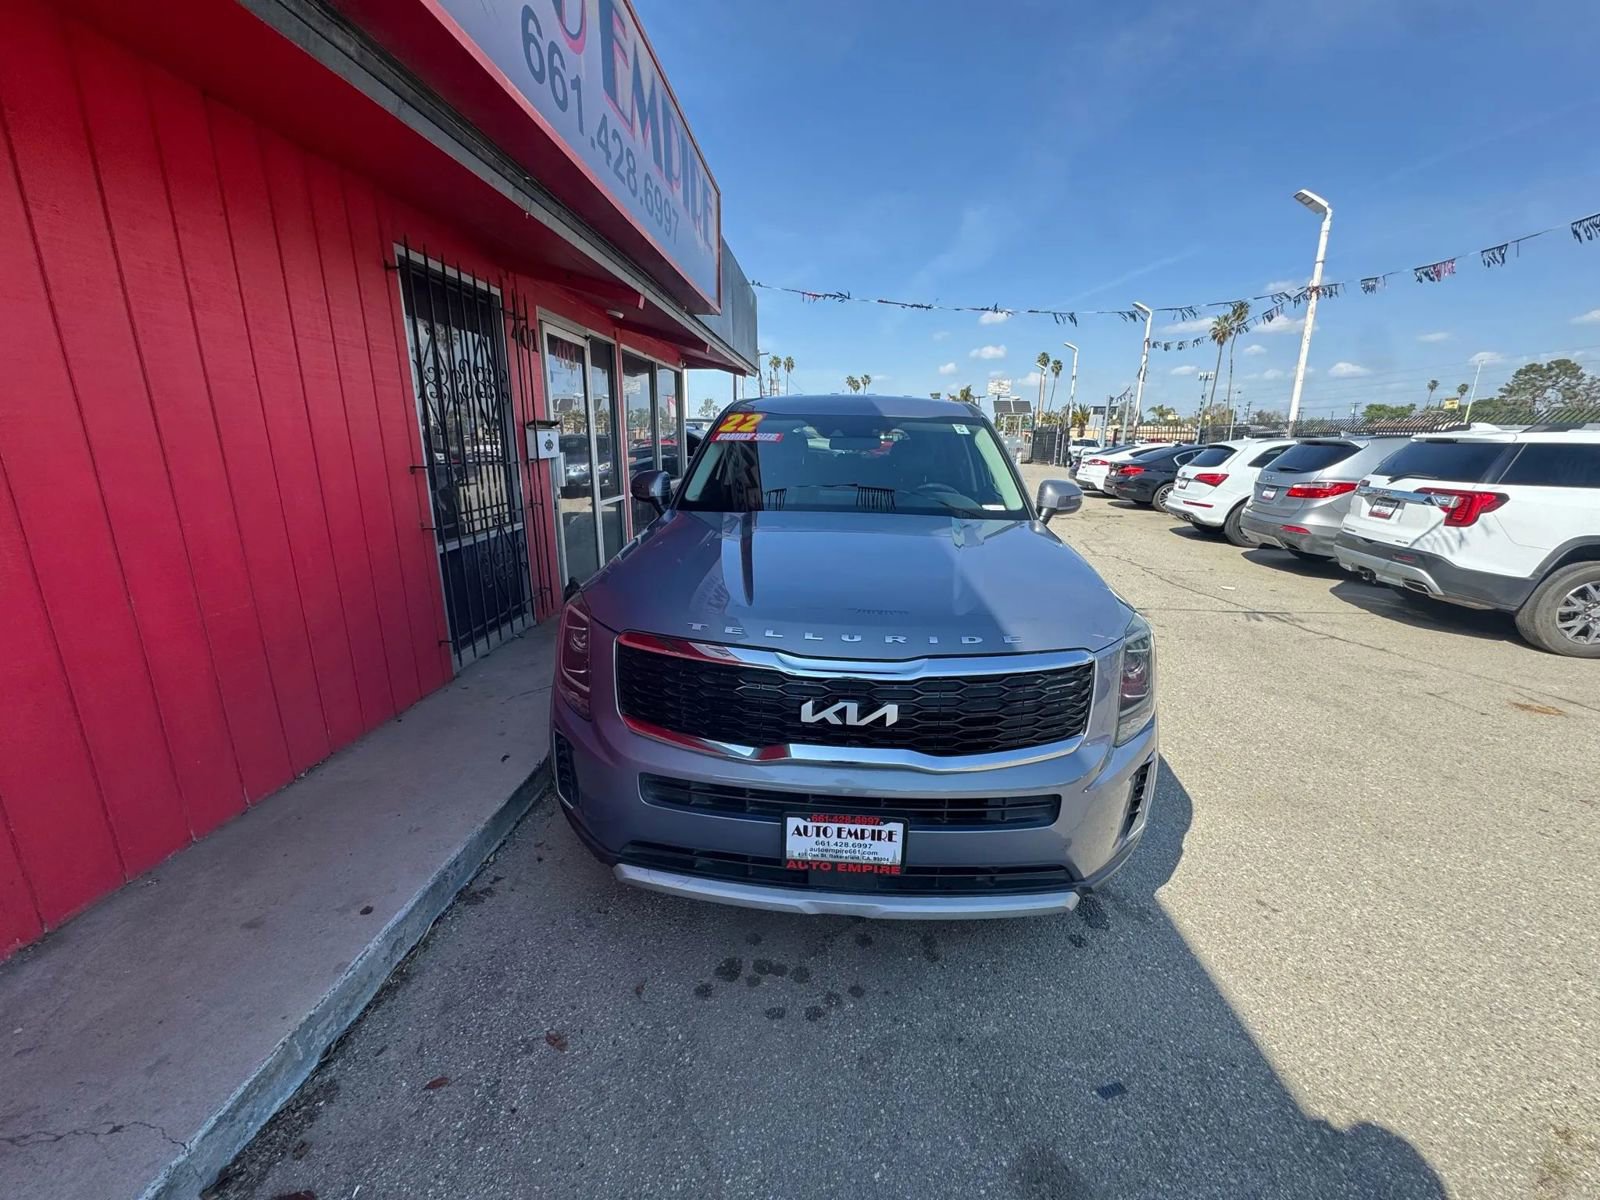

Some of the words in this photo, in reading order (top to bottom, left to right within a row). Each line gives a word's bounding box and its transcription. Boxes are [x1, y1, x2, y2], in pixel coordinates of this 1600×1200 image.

[520, 4, 681, 245] 661.428.6997
[598, 0, 713, 250] EMPIRE
[718, 413, 763, 432] 22
[687, 621, 1025, 645] TELLURIDE
[800, 699, 899, 727] KIA
[792, 825, 834, 838] AUTO
[837, 827, 897, 842] EMPIRE
[815, 840, 873, 849] 661.428.6997
[786, 859, 832, 871] AUTO
[837, 862, 902, 875] EMPIRE
